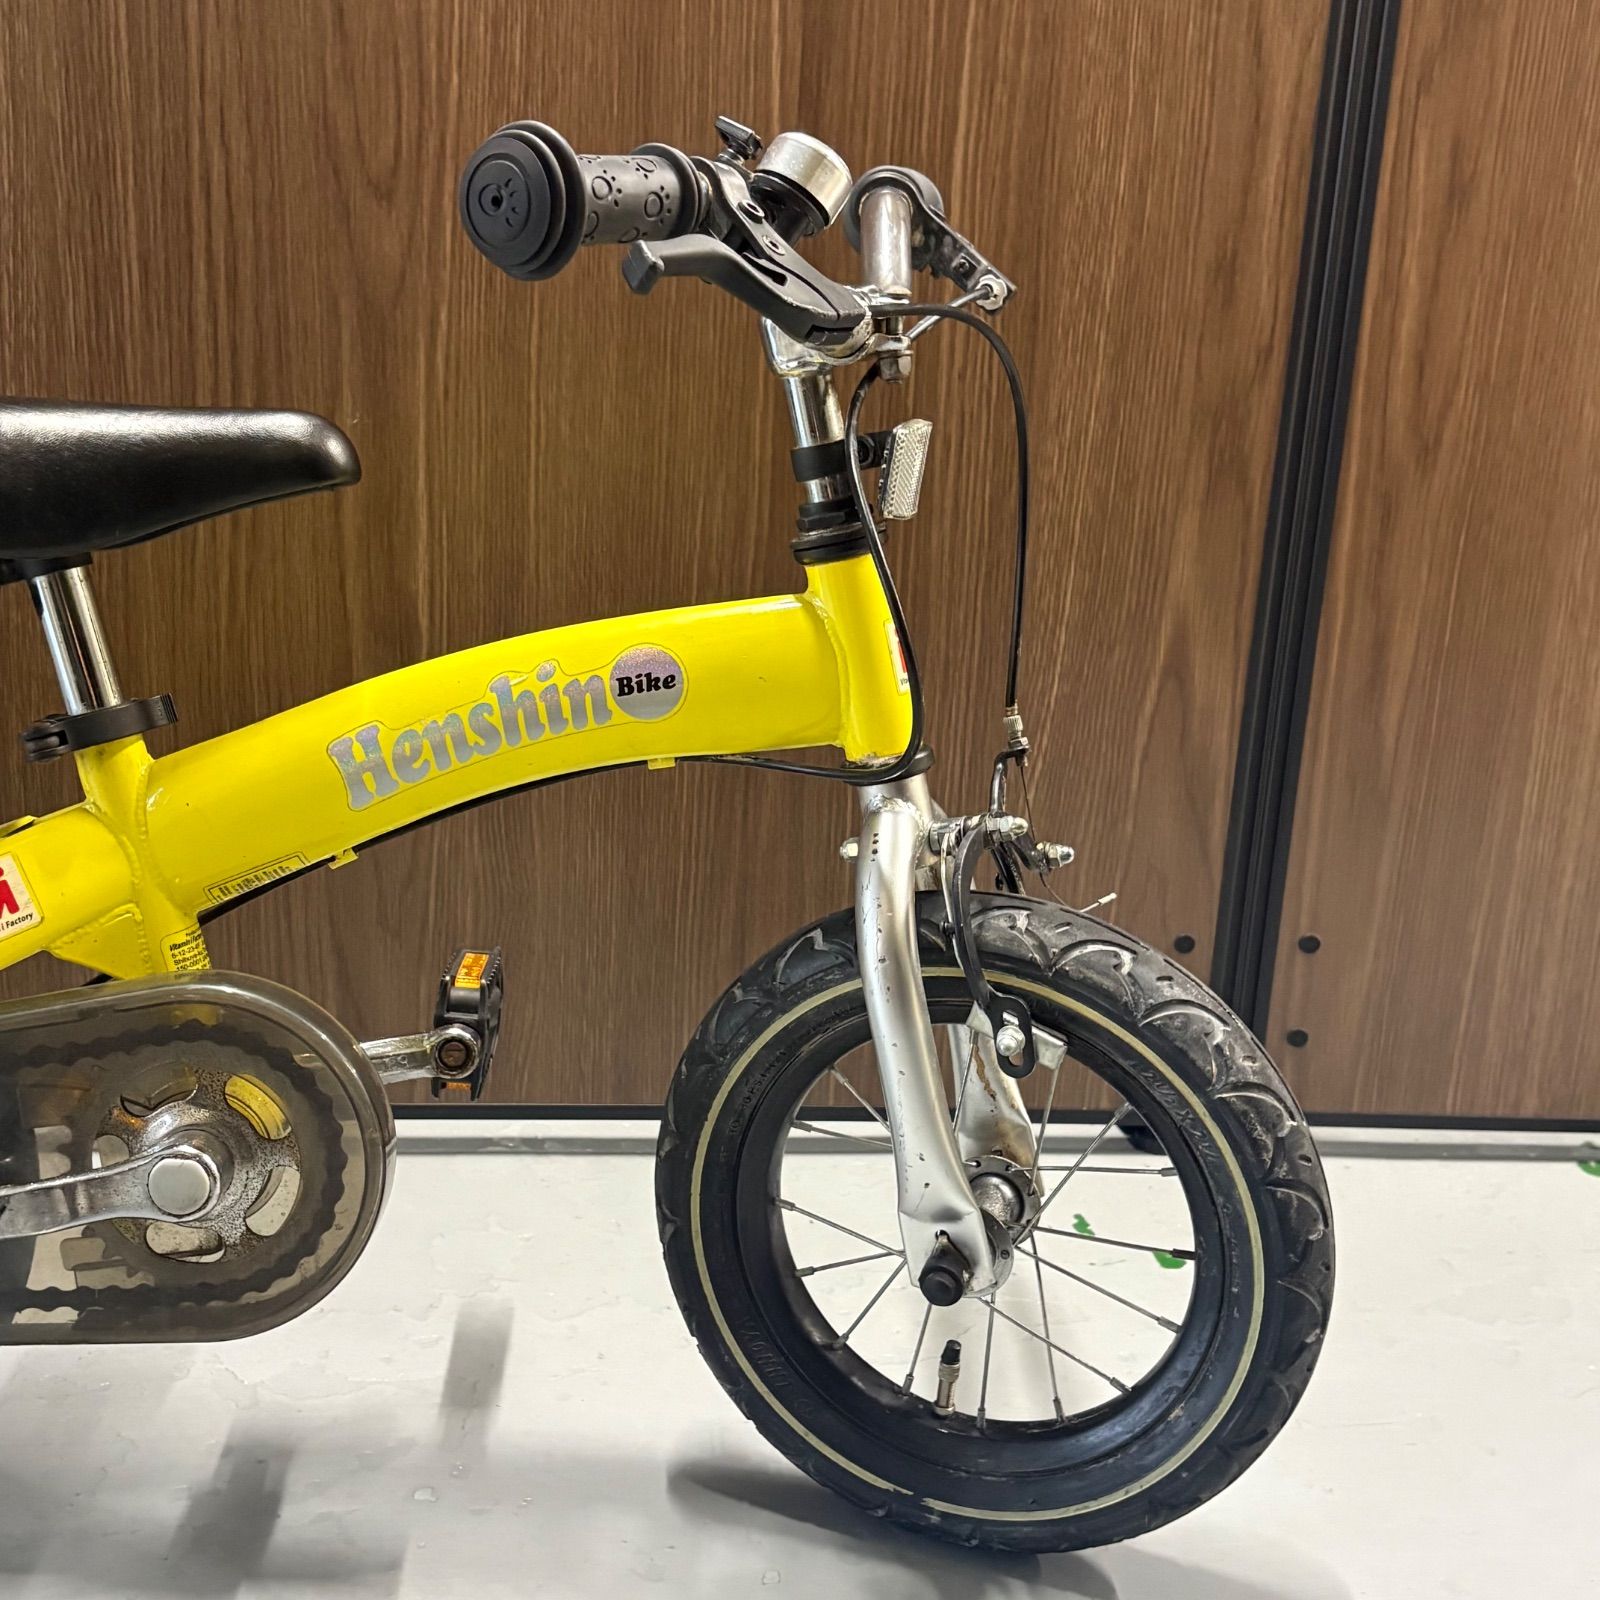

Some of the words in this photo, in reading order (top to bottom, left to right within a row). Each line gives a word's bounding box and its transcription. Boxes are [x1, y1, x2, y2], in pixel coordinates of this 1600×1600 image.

[328, 660, 613, 810] Henshin
[615, 673, 677, 698] Bike
[6, 911, 34, 929] Factory
